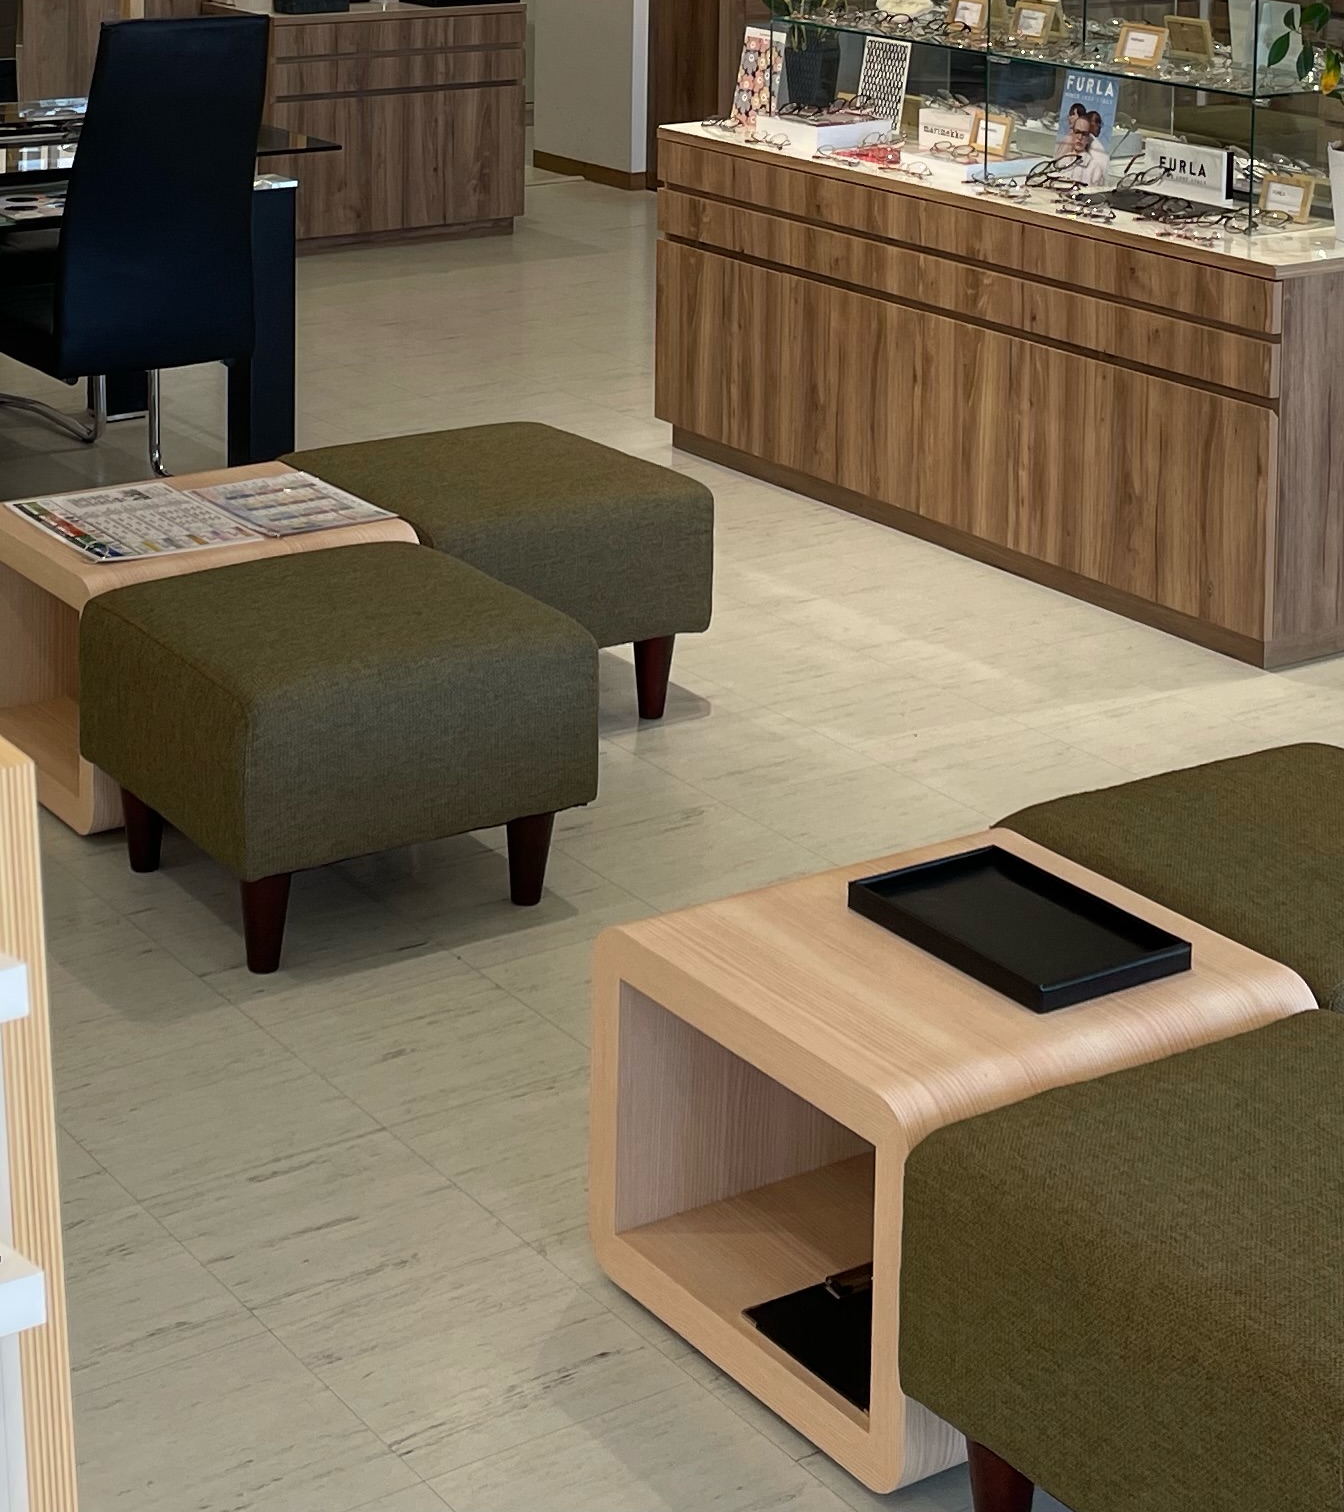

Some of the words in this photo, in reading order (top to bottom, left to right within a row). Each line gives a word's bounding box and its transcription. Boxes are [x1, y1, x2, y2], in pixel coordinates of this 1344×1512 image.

[1066, 74, 1115, 98] FURLA
[923, 125, 965, 140] marimekko
[1159, 155, 1207, 178] FURLA
